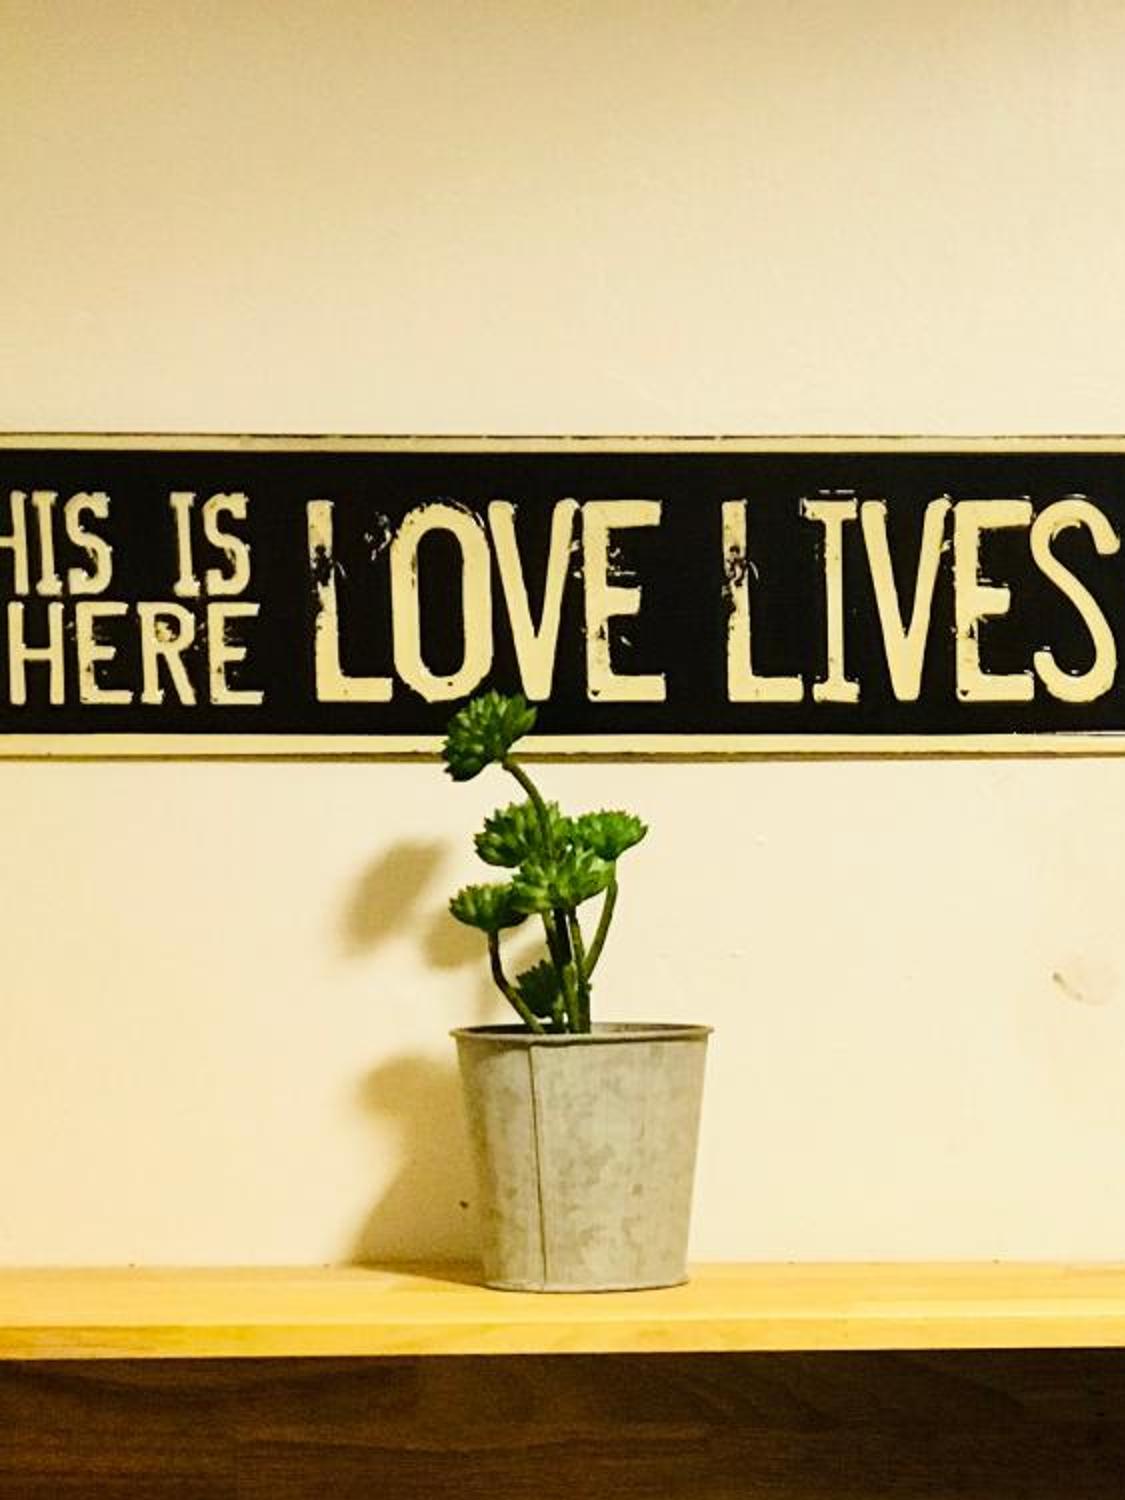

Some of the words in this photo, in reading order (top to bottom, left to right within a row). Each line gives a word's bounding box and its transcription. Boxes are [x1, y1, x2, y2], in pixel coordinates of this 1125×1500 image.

[169, 491, 251, 598] IS
[306, 498, 666, 702] LOVE
[722, 496, 1120, 702] LIVES
